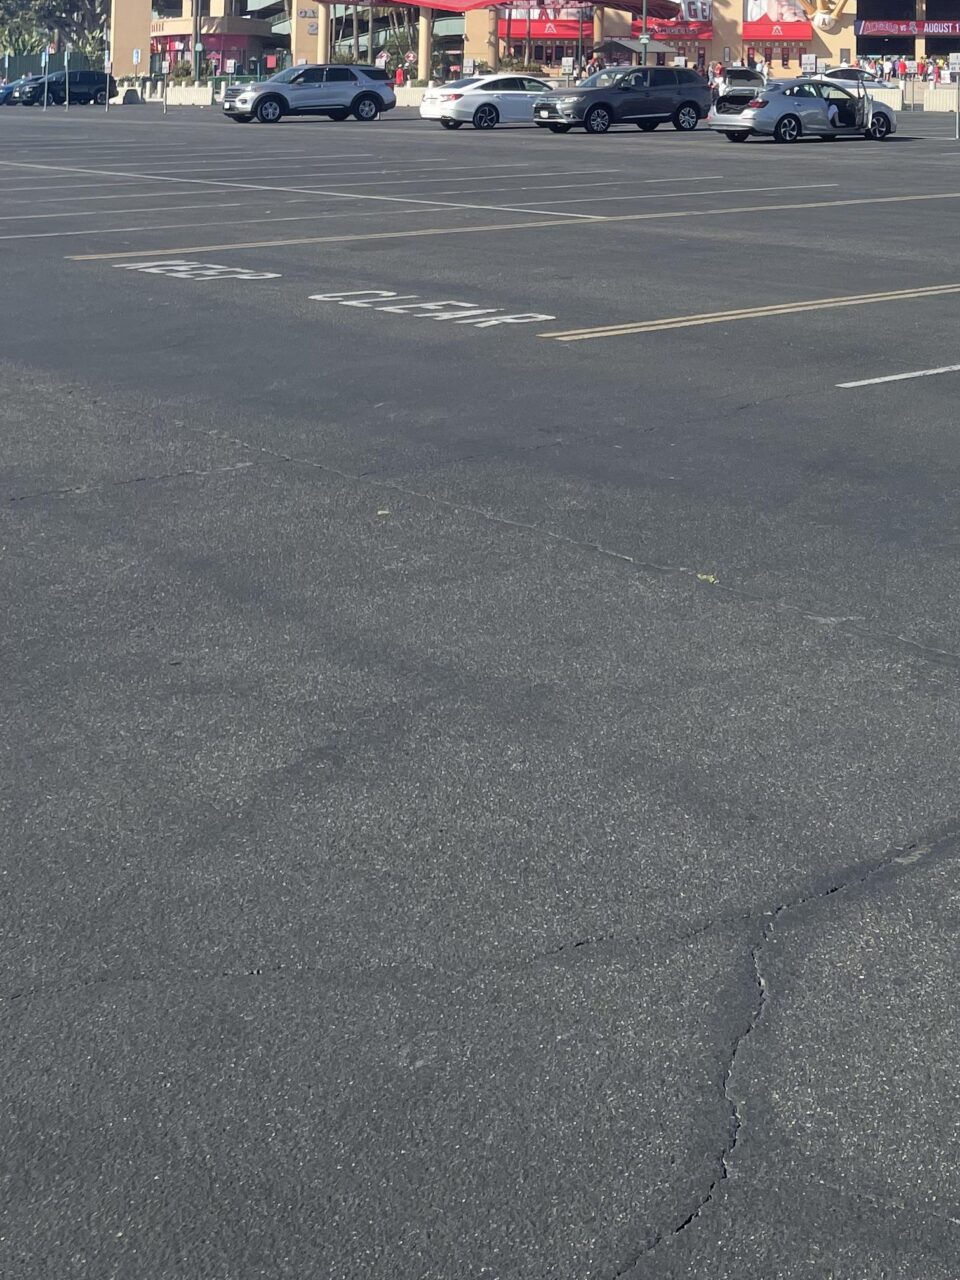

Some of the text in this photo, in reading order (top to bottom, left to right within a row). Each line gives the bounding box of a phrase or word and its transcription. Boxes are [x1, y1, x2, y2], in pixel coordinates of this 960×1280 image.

[924, 23, 952, 33] AUGUST
[112, 260, 282, 281] KEEP
[308, 290, 556, 328] CLEAR
